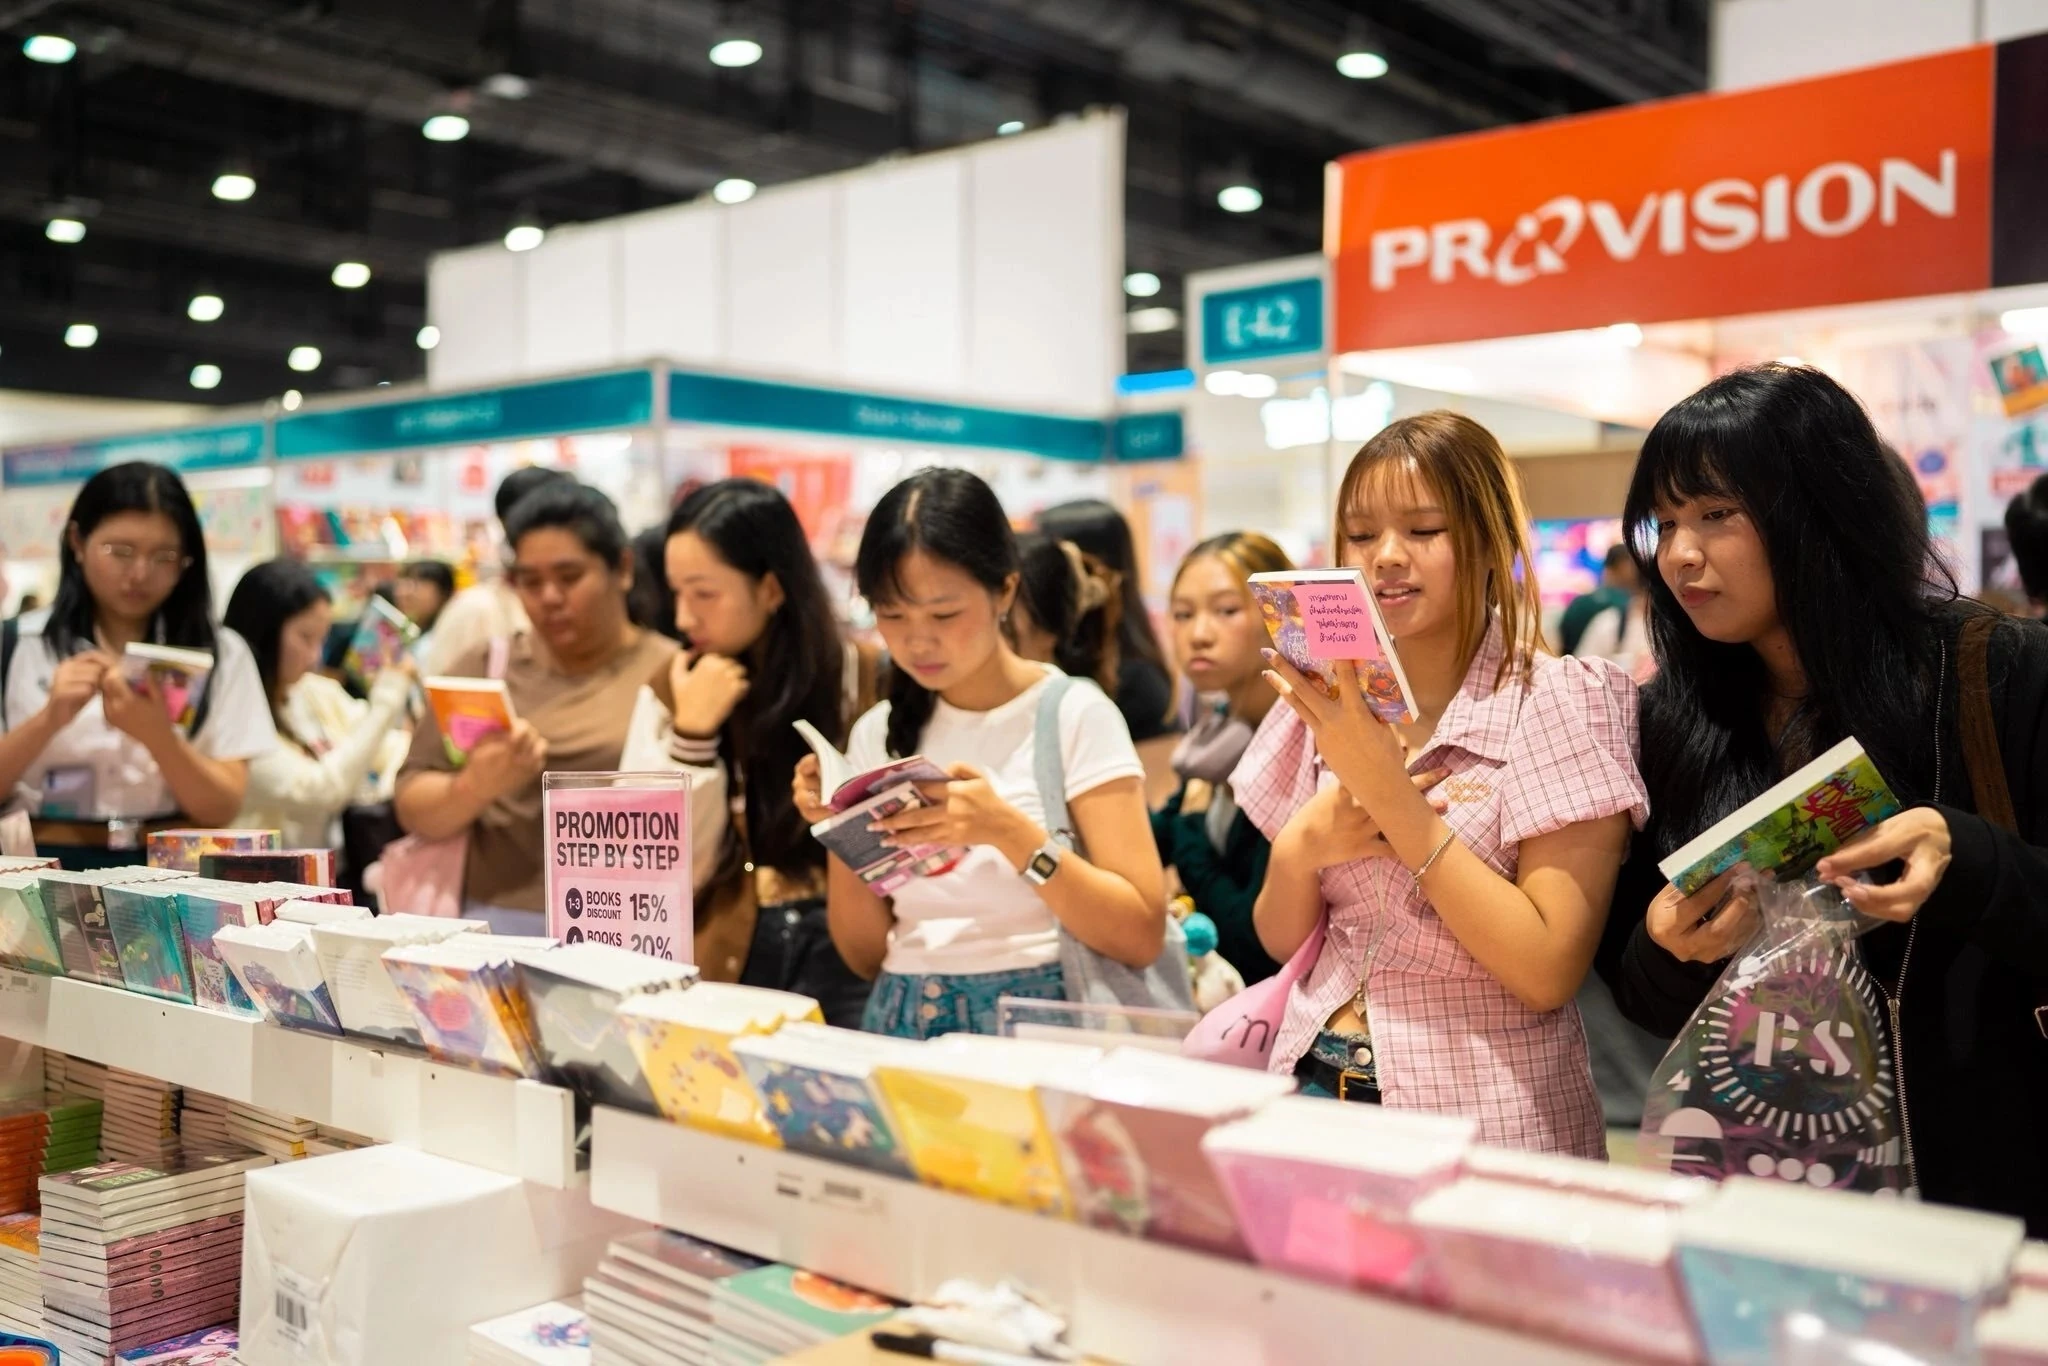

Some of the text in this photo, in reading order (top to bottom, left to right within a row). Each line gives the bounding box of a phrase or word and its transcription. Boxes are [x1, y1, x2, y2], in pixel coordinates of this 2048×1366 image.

[556, 811, 679, 840] PROMOTION
[557, 843, 679, 870] STEP BY STEP
[568, 891, 621, 910] 1-3 BOOKS
[587, 908, 621, 920] DISCOUNT
[629, 893, 667, 922] 15%
[587, 930, 622, 947] BOOKS
[631, 933, 672, 961] 20%
